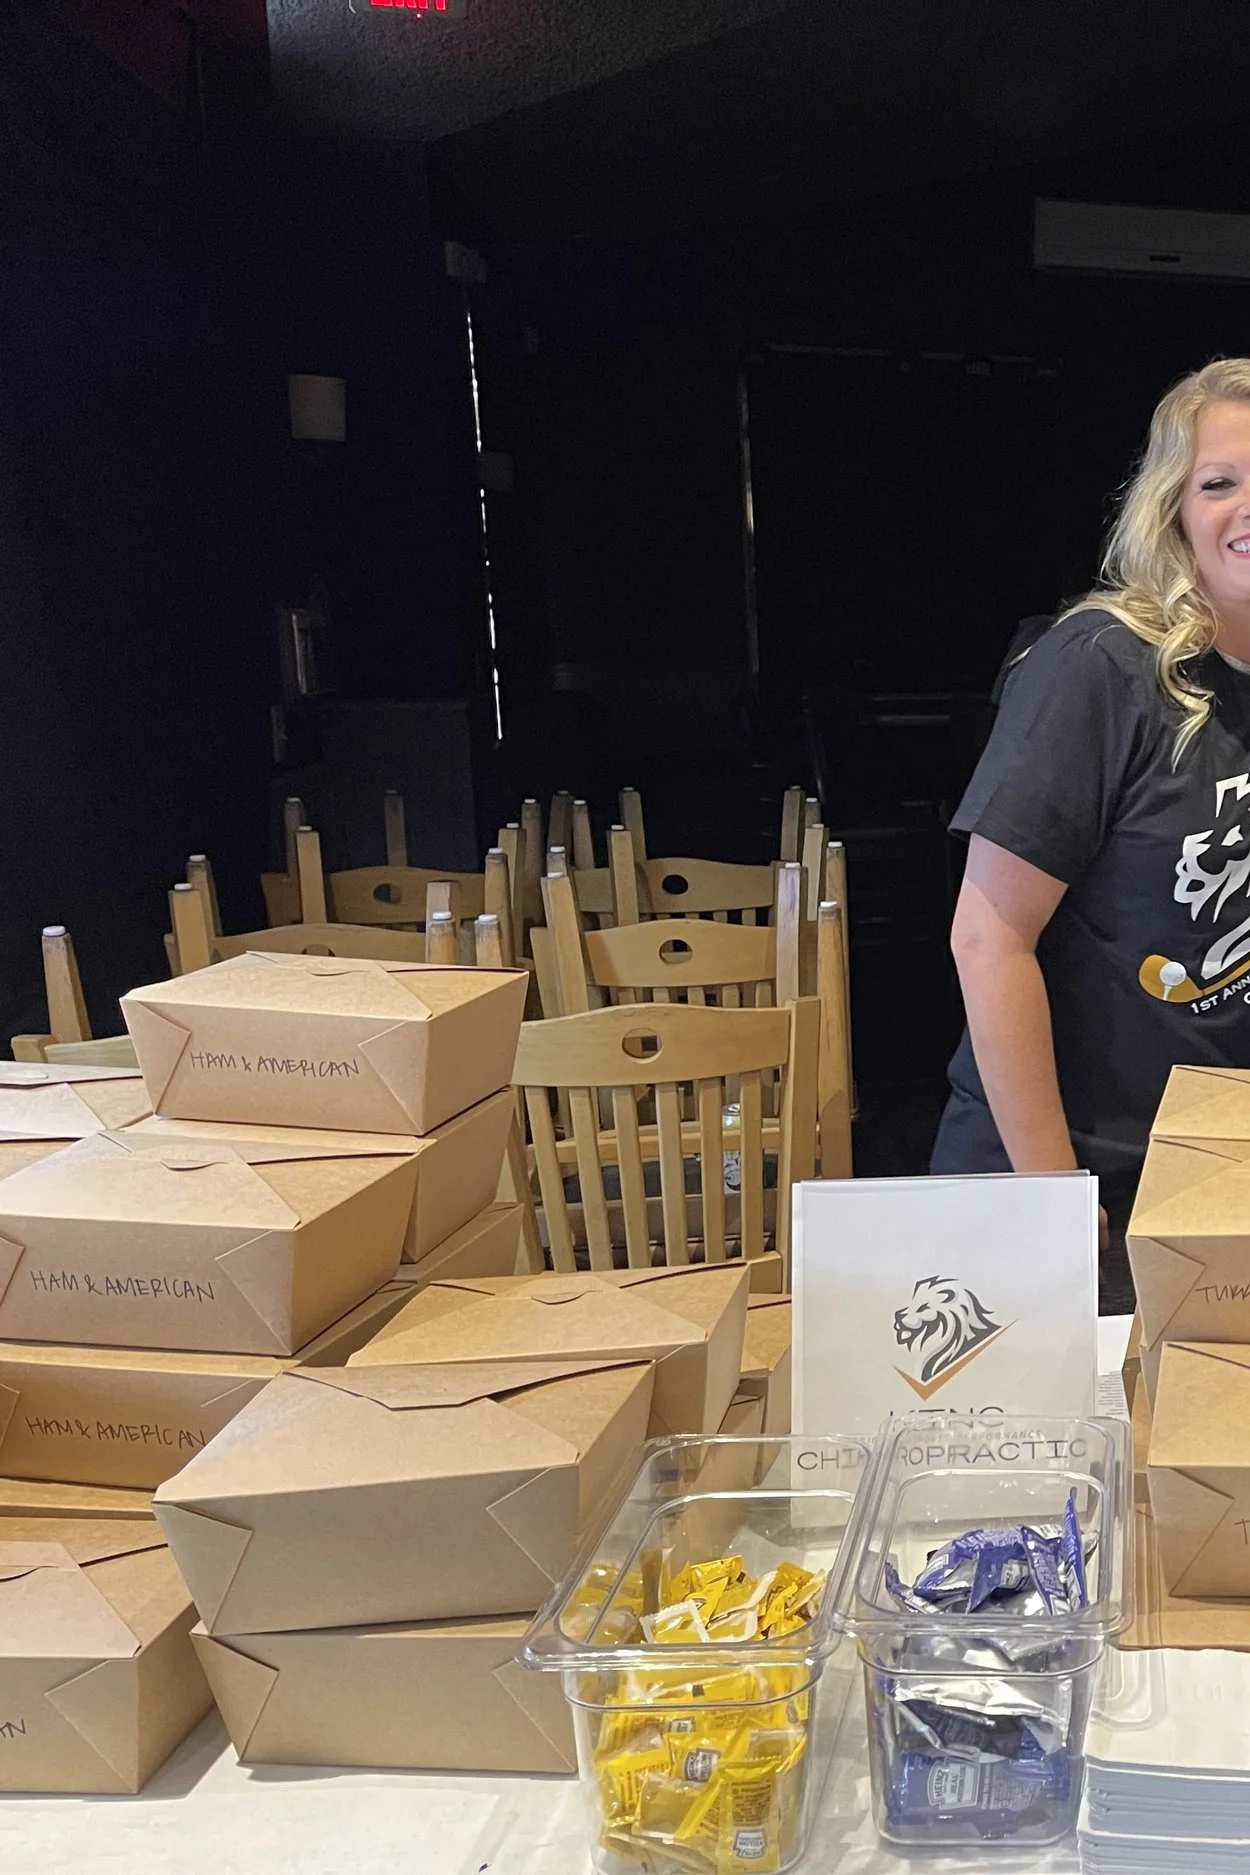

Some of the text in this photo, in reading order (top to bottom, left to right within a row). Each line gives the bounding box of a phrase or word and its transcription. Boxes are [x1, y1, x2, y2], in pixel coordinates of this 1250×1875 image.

[1190, 995, 1219, 1014] 1ST
[189, 1050, 237, 1069] HAM
[257, 1055, 360, 1078] AMERICAN
[30, 1270, 216, 1302] HAM & AMERICAN
[25, 1415, 206, 1449] HAM & AMERICAN
[933, 1769, 945, 1800] HEINZ
